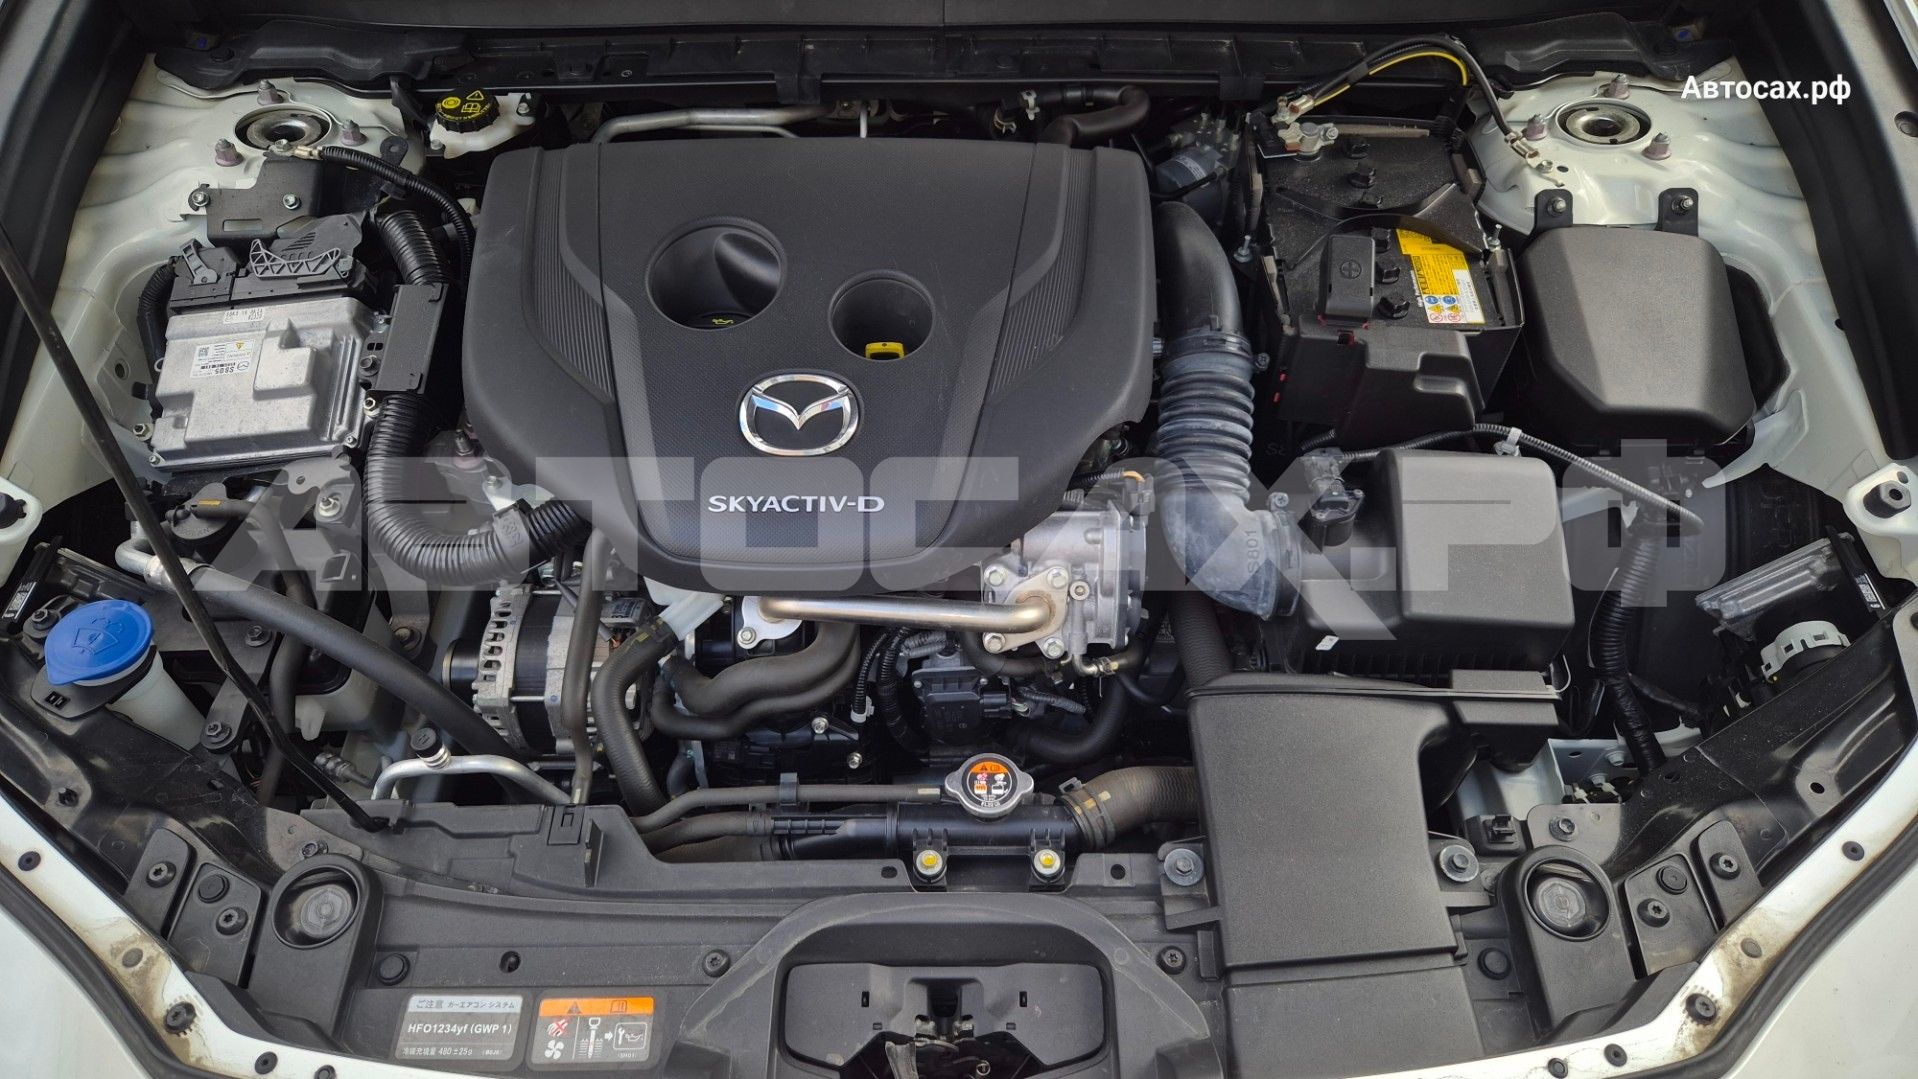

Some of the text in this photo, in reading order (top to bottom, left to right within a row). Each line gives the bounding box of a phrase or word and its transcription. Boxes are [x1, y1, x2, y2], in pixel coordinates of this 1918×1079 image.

[707, 494, 885, 513] SKYACTIV-D
[1244, 529, 1260, 574] S801
[407, 1023, 512, 1036] HFO1234yf (GWP 1)
